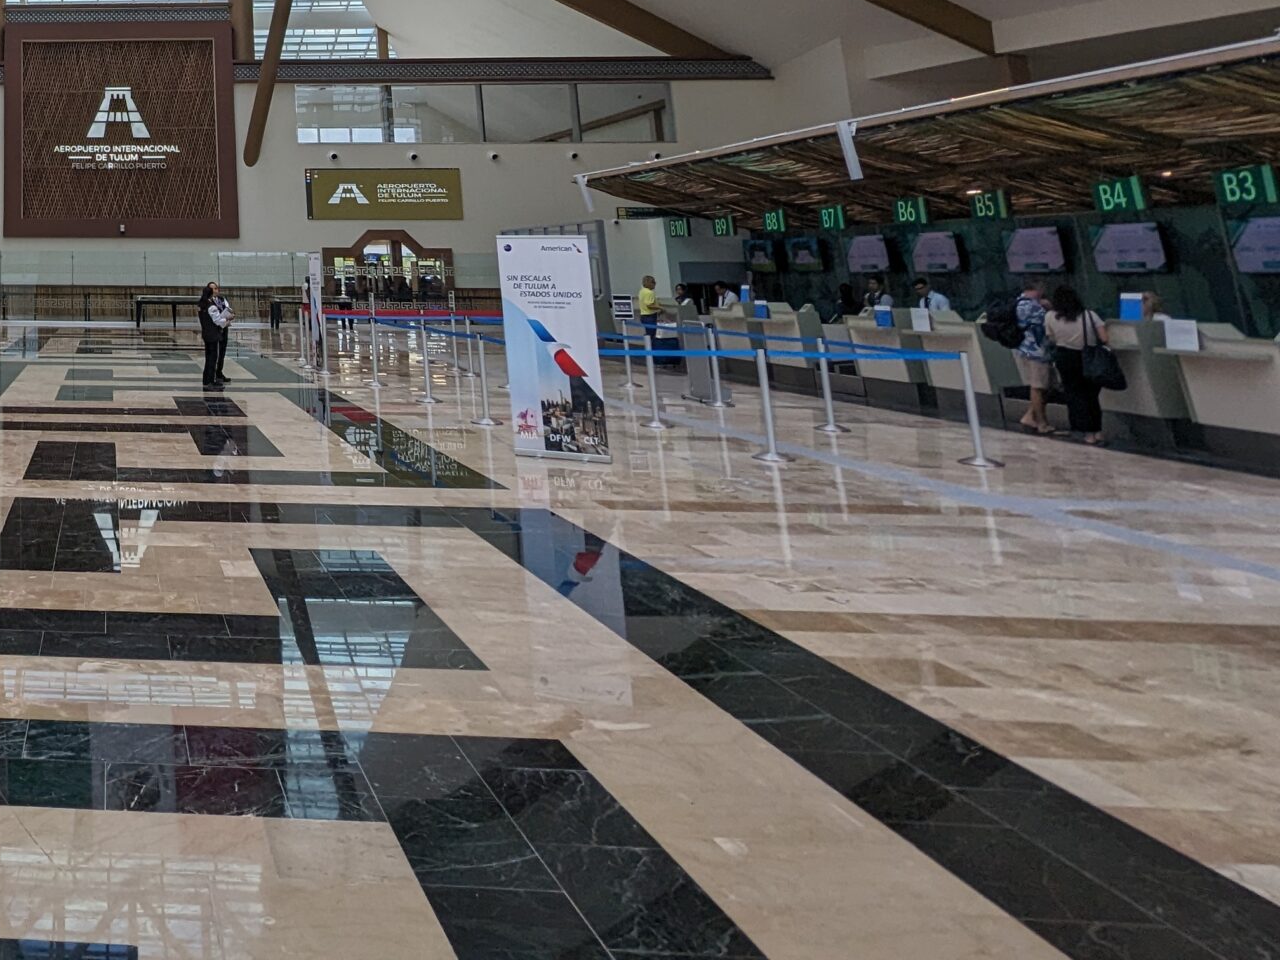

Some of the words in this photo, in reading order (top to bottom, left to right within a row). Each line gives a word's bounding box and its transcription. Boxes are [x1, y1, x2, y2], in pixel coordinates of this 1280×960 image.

[53, 145, 111, 153] AEROPUERTO
[112, 145, 181, 153] INTERNACIONAL
[95, 153, 108, 161] DE
[109, 153, 138, 161] TULUM
[71, 162, 96, 170] FELIPE
[98, 162, 135, 170] CARRILLO
[136, 162, 167, 170] PUERTO
[1221, 171, 1257, 202] B3
[974, 193, 995, 217] B5
[1098, 182, 1128, 211] B4
[821, 209, 835, 230] B7
[896, 200, 916, 222] B6
[669, 220, 684, 236] B10
[714, 218, 727, 235] B9
[765, 211, 778, 231] B8
[552, 291, 582, 299] UNIDOS
[520, 431, 538, 440] MIA
[549, 433, 571, 443] DFW
[583, 436, 600, 446] CLT
